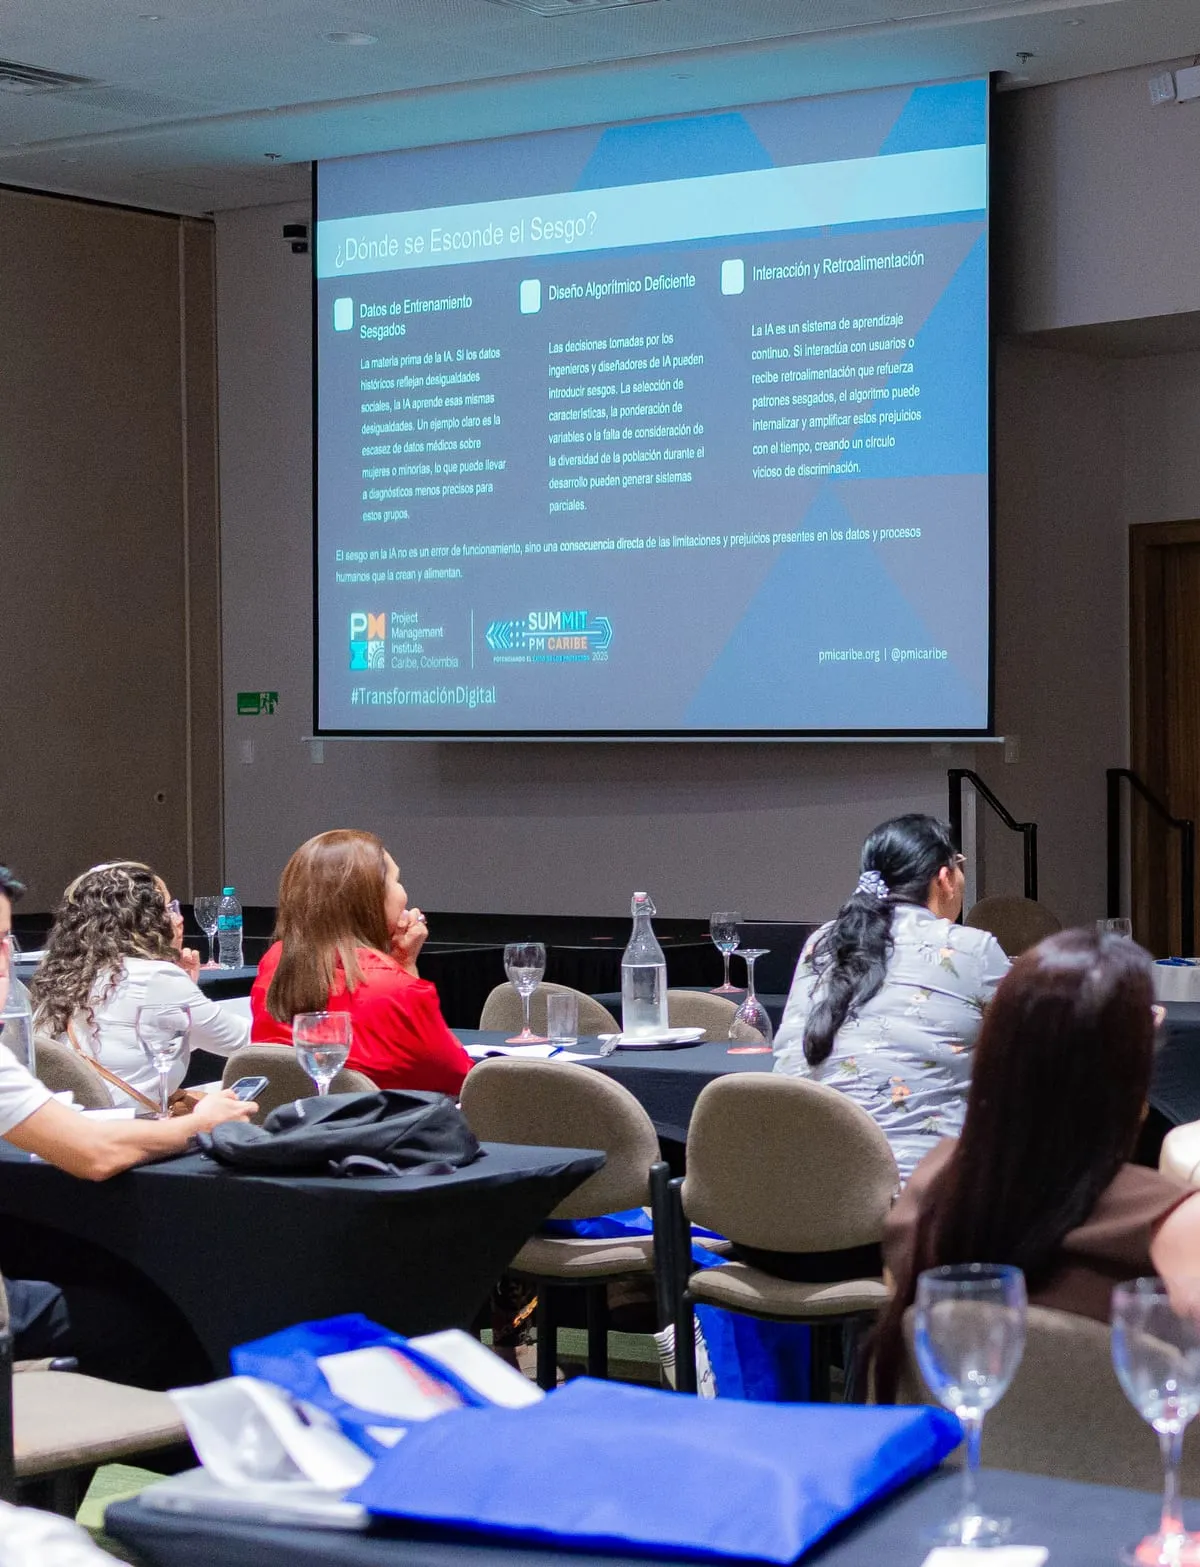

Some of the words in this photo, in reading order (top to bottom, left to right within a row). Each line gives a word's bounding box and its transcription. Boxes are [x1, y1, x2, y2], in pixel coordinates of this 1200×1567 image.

[335, 233, 399, 269] ¿Dónde
[404, 235, 424, 255] se
[430, 222, 504, 252] Esconde
[509, 219, 524, 243] el
[530, 210, 597, 244] Sesgo?
[752, 260, 810, 281] Interacción
[813, 263, 820, 279] y
[823, 251, 924, 274] Retroalimentación
[548, 283, 583, 301] Diseño
[584, 278, 642, 300] Algorítmico
[644, 272, 696, 291] Deficiente
[360, 303, 387, 318] Datos
[389, 300, 402, 315] de
[403, 294, 472, 314] Entrenamiento
[360, 321, 406, 341] Sesgados
[751, 324, 762, 337] La
[764, 322, 774, 336] IA
[775, 324, 786, 335] es
[788, 323, 800, 334] un
[801, 319, 837, 333] sistema
[838, 316, 850, 330] de
[852, 312, 904, 331] aprendizaje
[751, 346, 791, 360] continuo.
[793, 344, 802, 357] Si
[804, 340, 848, 356] interactúa
[850, 342, 867, 353] con
[868, 336, 906, 351] usuarios
[907, 337, 915, 348] o
[751, 370, 779, 384] recibe
[780, 365, 856, 382] retroalimentación
[857, 365, 874, 379] que
[876, 361, 914, 375] refuerza
[752, 395, 790, 411] patrones
[791, 390, 837, 407] sesgados,
[838, 389, 847, 402] el
[849, 387, 890, 403] algoritmo
[891, 384, 920, 400] puede
[752, 416, 800, 431] internalizar
[801, 418, 807, 431] y
[808, 413, 852, 429] amplificar
[852, 411, 877, 425] estos
[878, 408, 922, 426] prejuicios
[752, 444, 768, 455] con
[770, 441, 778, 454] el
[780, 441, 812, 455] tiempo,
[814, 437, 850, 451] creando
[851, 438, 863, 449] un
[865, 434, 895, 448] círculo
[752, 465, 782, 479] vicioso
[784, 464, 796, 477] de
[797, 460, 861, 476] discriminación.
[391, 611, 418, 627] Project
[528, 610, 588, 631] SUMMIT
[391, 626, 444, 641] Management
[528, 637, 544, 651] PM
[547, 635, 588, 650] CARIBE
[390, 655, 419, 671] Caribe,
[419, 655, 459, 668] Colombia
[818, 647, 880, 664] pmicaribe.org
[890, 647, 948, 662] @pmicaribe
[351, 685, 496, 708] #TransformaciónDigital
